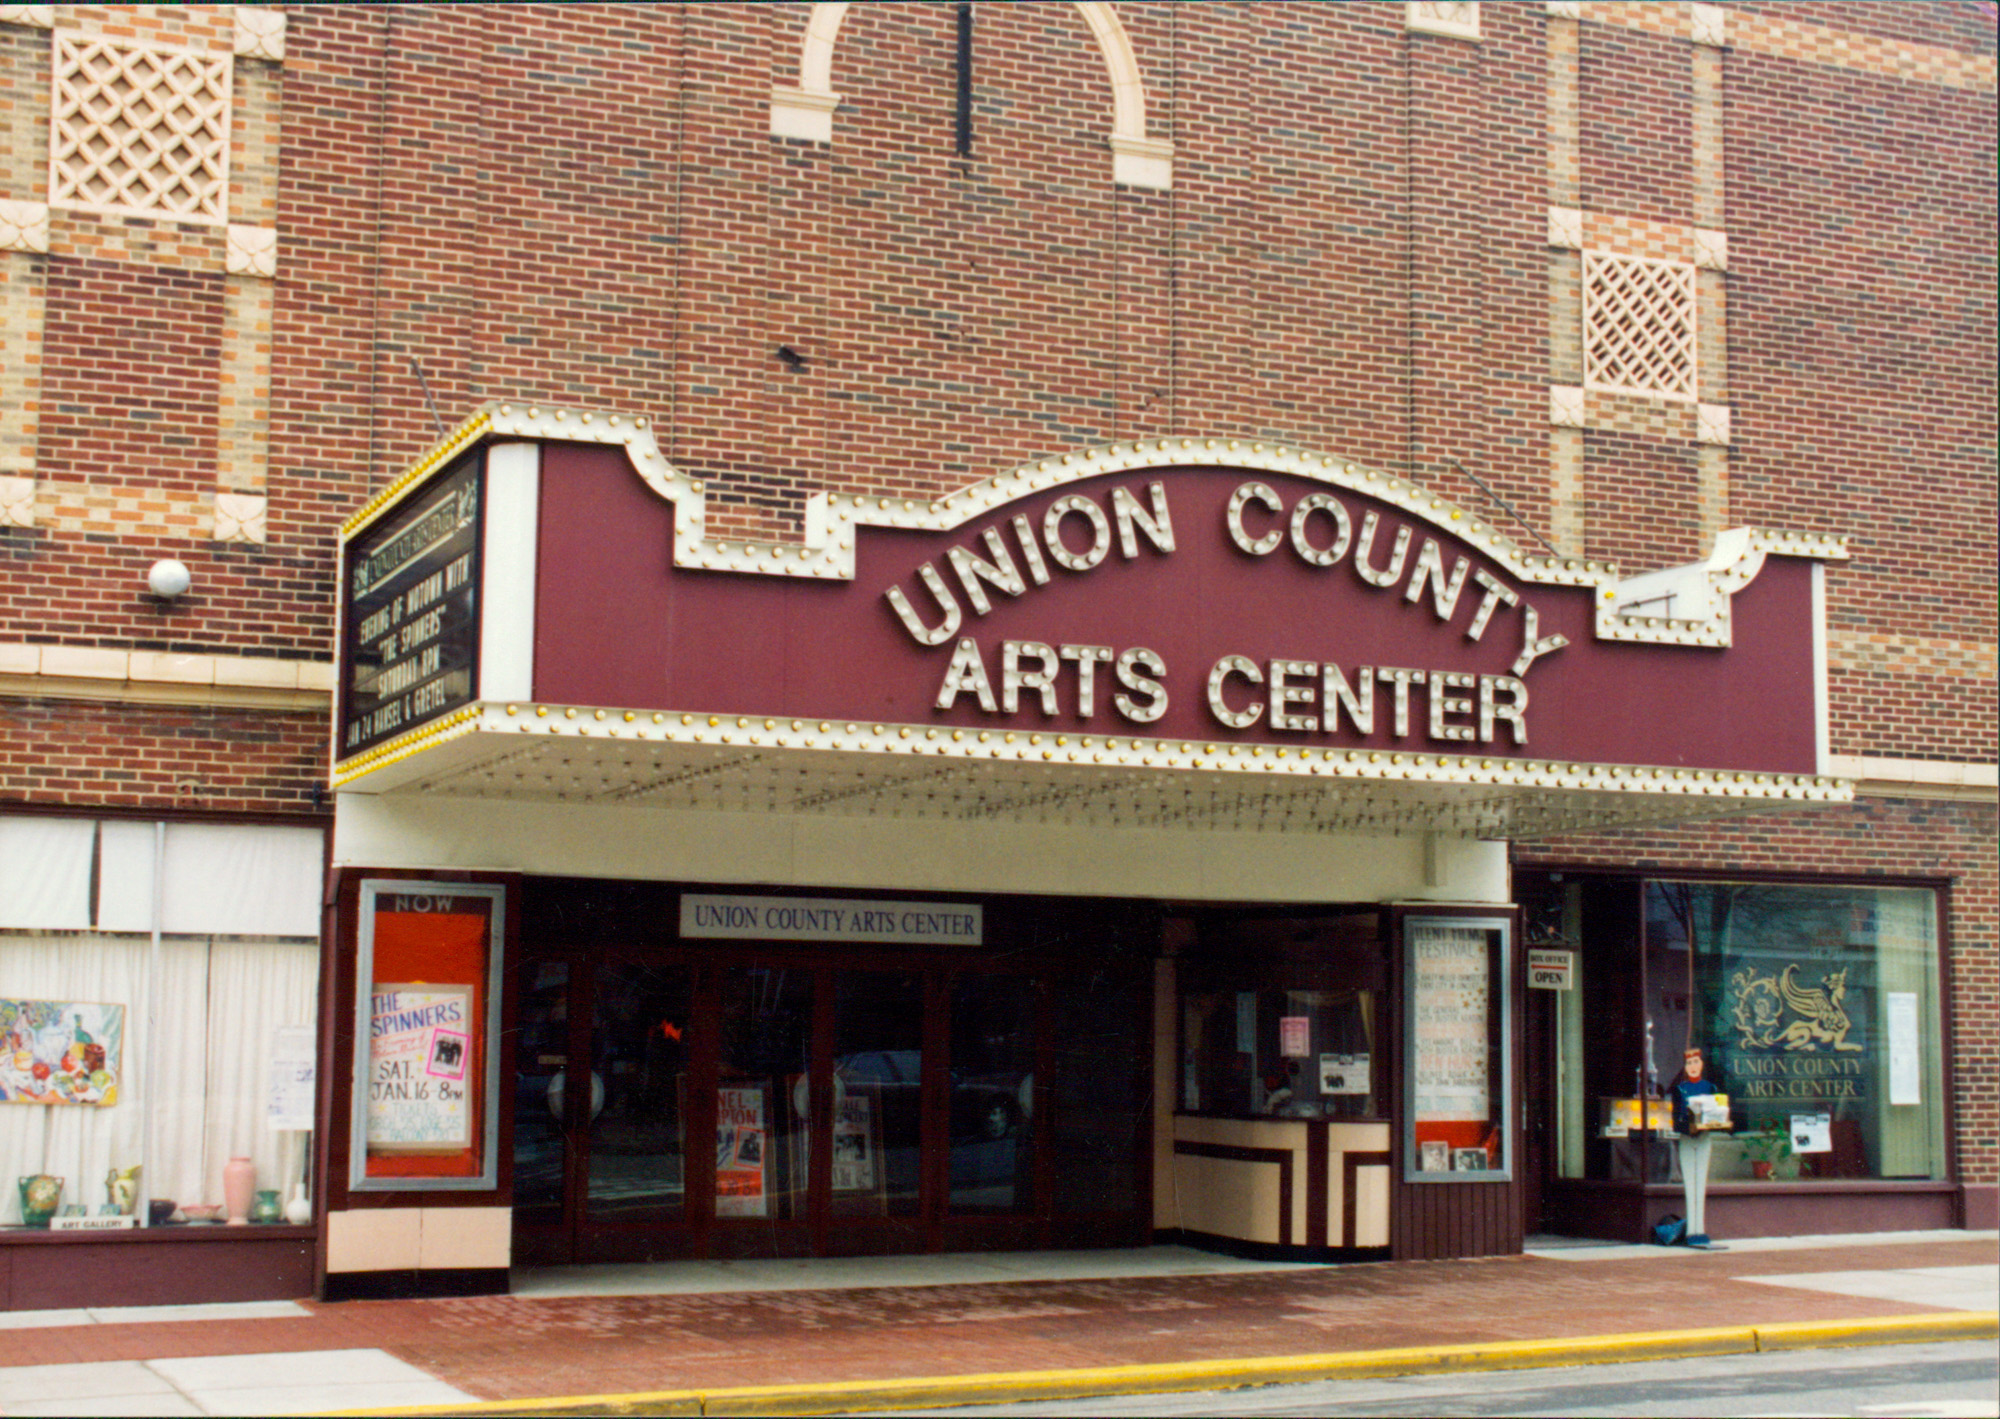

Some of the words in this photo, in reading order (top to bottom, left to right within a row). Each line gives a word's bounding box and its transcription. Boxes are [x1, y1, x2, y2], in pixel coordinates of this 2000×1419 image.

[885, 481, 1176, 645] UNION
[1227, 481, 1570, 677] COUNTY
[360, 604, 390, 646] EVENING
[392, 595, 403, 625] OF
[407, 570, 443, 616] MOTOWN
[446, 553, 469, 592] WITH
[378, 654, 418, 700] SATURDAY
[422, 643, 440, 677] 8PM
[934, 637, 1169, 723] ARTS
[1207, 654, 1530, 745] CENTER
[346, 720, 360, 749] JAN
[362, 714, 372, 740] 24
[374, 699, 401, 736] HANSEL
[414, 677, 446, 716] GRETEL
[395, 895, 453, 913] NOW
[695, 904, 759, 929] UNION
[765, 907, 846, 931] COUNTY
[849, 910, 896, 934] ARTS
[901, 911, 976, 936] CENTER
[1419, 942, 1475, 959] FESTIVAL
[1530, 954, 1543, 962] BOX
[1545, 954, 1568, 964] OFFICE
[1534, 971, 1563, 984] OPEN
[371, 991, 402, 1016] THE
[370, 1000, 461, 1038] SPINNERS
[379, 1059, 415, 1080] SAT.
[1733, 1058, 1788, 1076] UNION
[1792, 1058, 1861, 1076] COUNTY
[371, 1081, 412, 1101] JAN.
[438, 1081, 463, 1101] 8PM
[1745, 1079, 1786, 1097] ARTS
[1788, 1079, 1857, 1097] CENTER
[718, 1091, 747, 1109] NEL
[62, 1221, 80, 1229] ART
[84, 1220, 123, 1228] GALLERY
